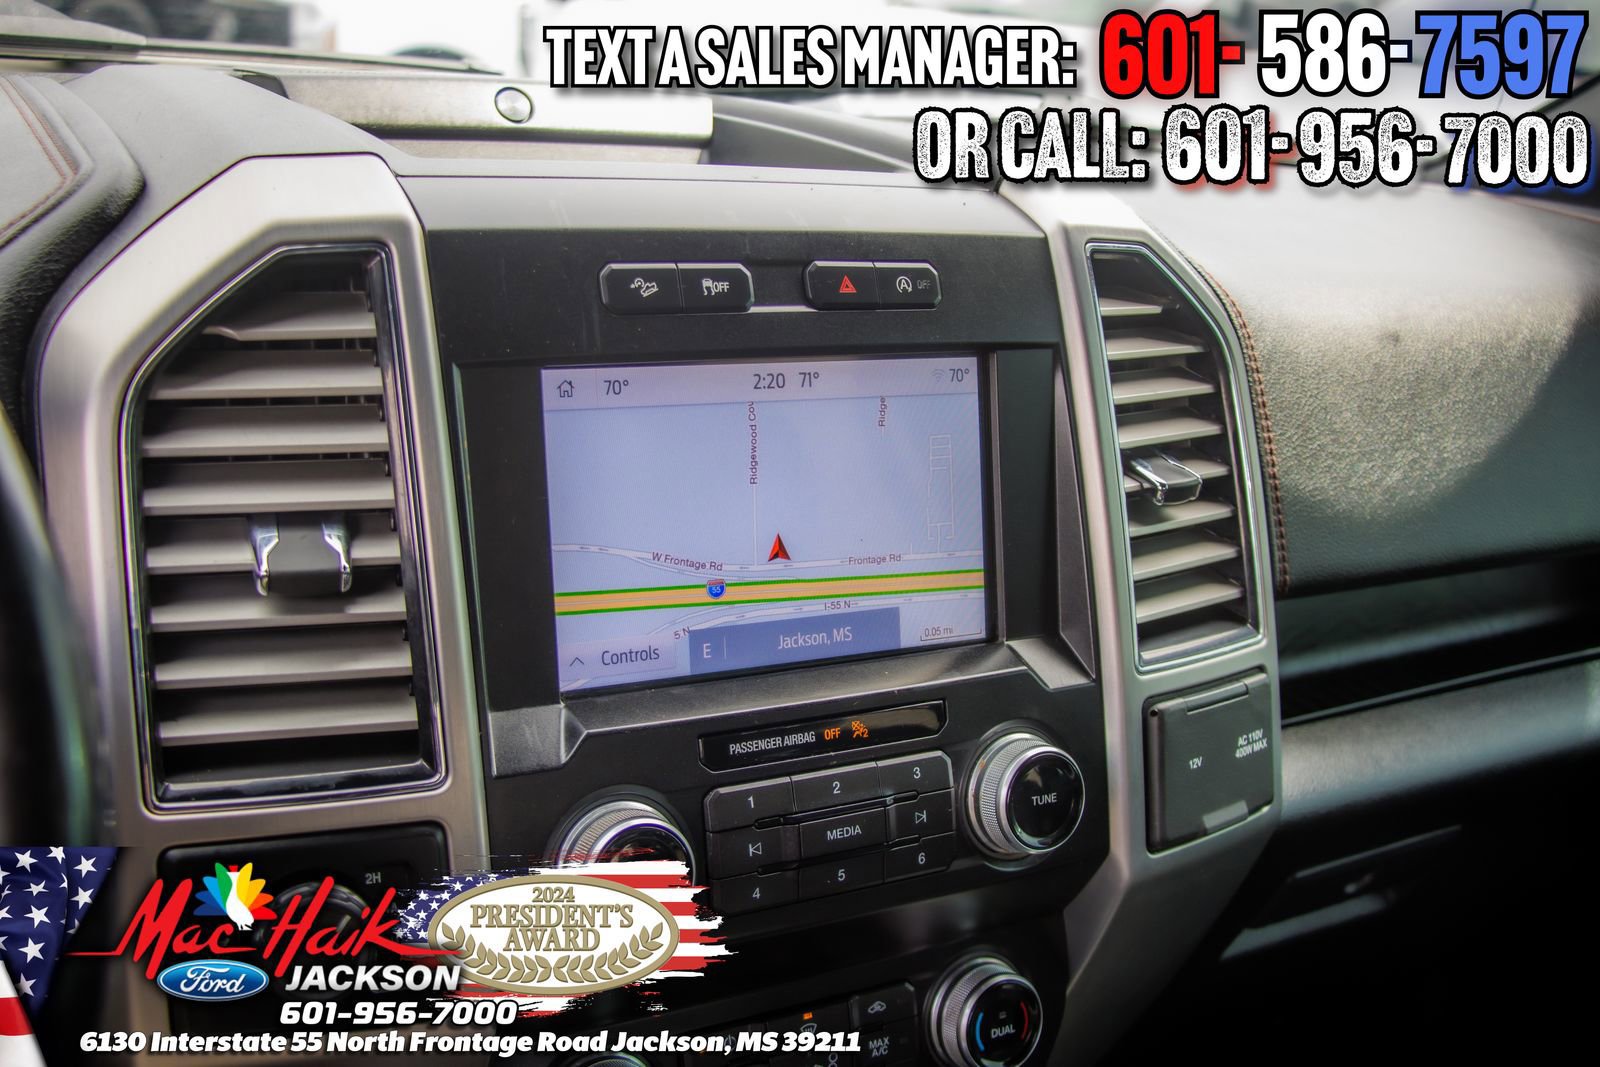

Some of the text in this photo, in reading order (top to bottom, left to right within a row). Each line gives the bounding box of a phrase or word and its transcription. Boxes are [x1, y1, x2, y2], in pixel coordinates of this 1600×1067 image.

[713, 281, 730, 293] OFF
[916, 280, 932, 289] OFF
[753, 371, 820, 390] 2:20 71°
[949, 367, 970, 383] 70°
[603, 378, 629, 395] 70°
[877, 396, 887, 427] Ridge
[748, 424, 759, 486] Ridgewood
[652, 551, 723, 571] W Frontage Rd
[848, 554, 901, 566] Frontage Rd
[823, 599, 851, 611] I-55 N
[924, 627, 942, 638] 0.05
[703, 627, 853, 658] E Jackson, MS
[601, 644, 660, 666] Controls
[729, 736, 783, 755] PASSENGER
[783, 731, 816, 747] AIRBAG
[824, 727, 841, 740] OFF
[1238, 734, 1248, 747] AC
[1253, 737, 1268, 753] MAX
[1189, 756, 1203, 770] 12V
[912, 766, 921, 779] 3
[832, 781, 841, 794] 2
[747, 796, 755, 809] 1
[1031, 792, 1058, 807] TUNE
[826, 825, 862, 841] MEDIA
[917, 852, 926, 865] 6
[365, 871, 382, 885] 2H
[837, 868, 846, 881] 5
[752, 887, 761, 899] 4
[991, 1023, 1016, 1039] DUAL
[869, 1035, 890, 1049] MAX
[871, 1046, 889, 1057] A/C
